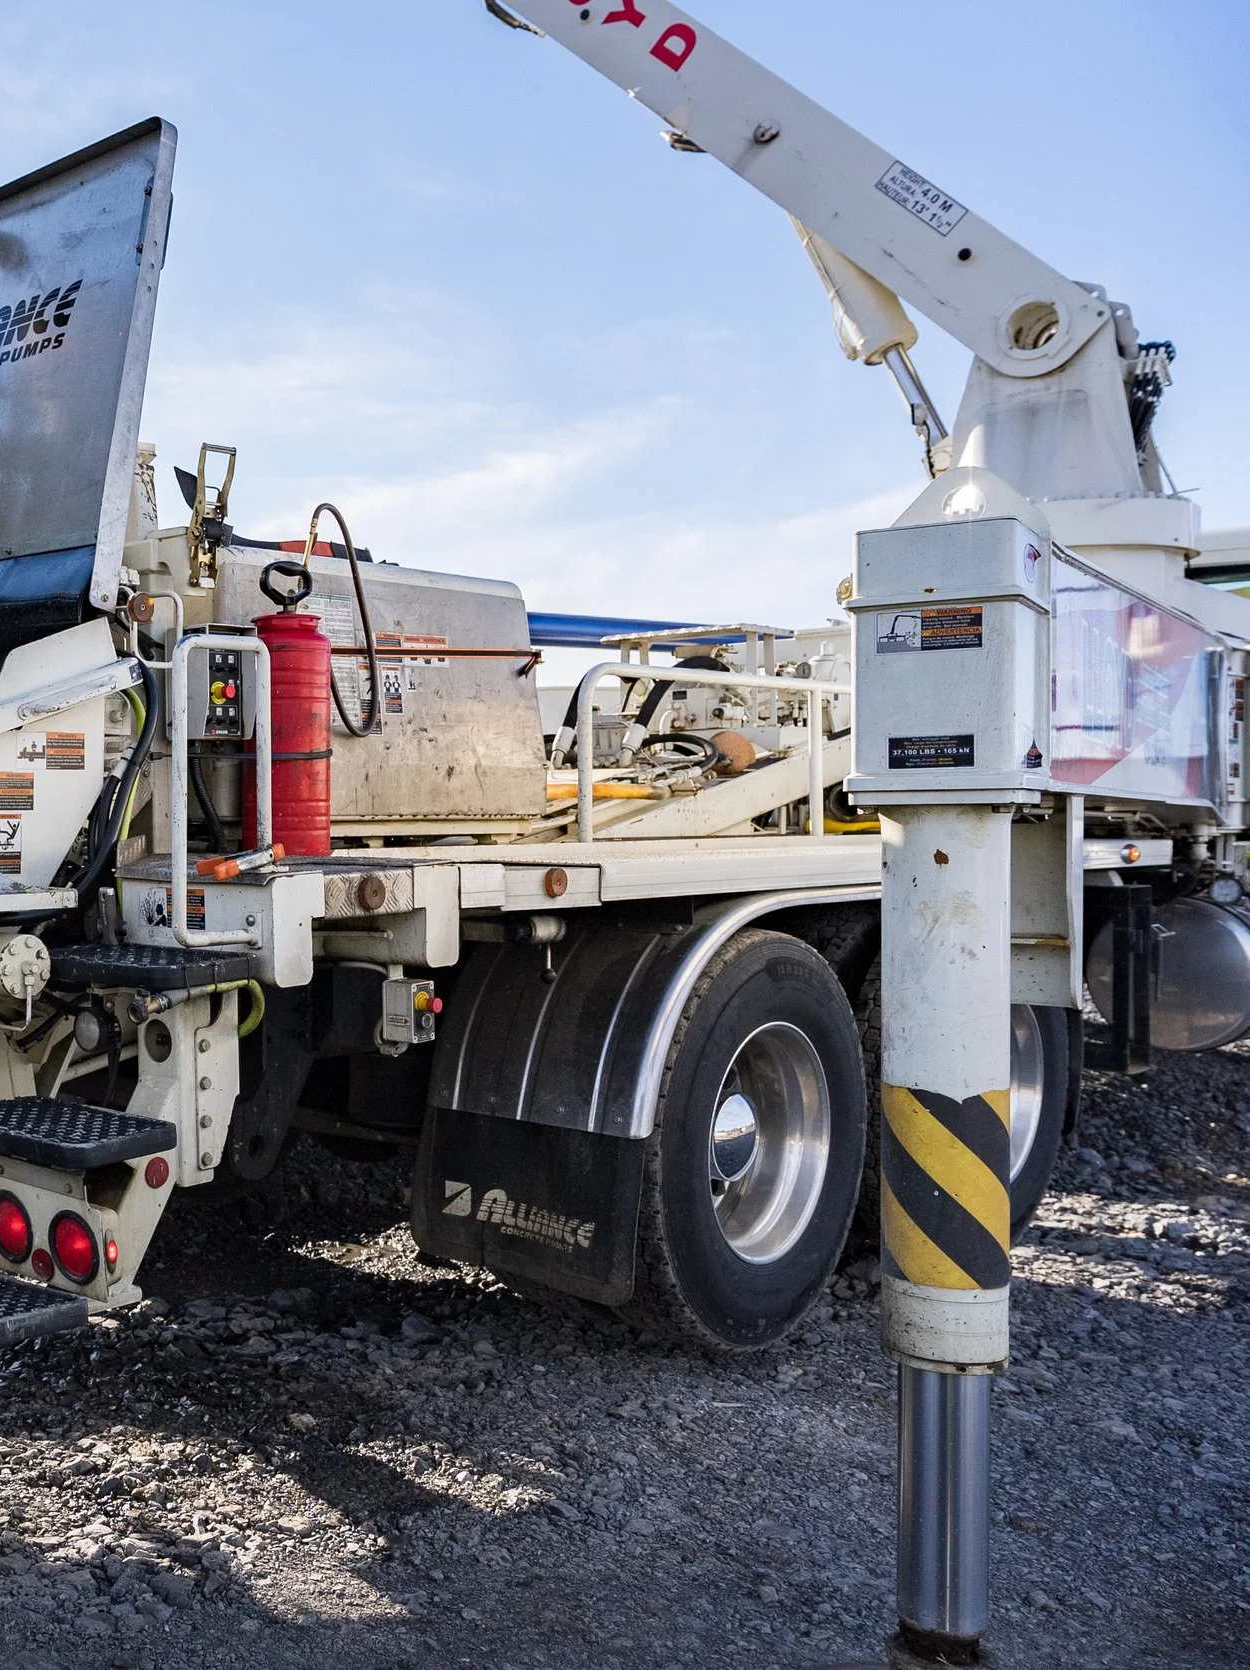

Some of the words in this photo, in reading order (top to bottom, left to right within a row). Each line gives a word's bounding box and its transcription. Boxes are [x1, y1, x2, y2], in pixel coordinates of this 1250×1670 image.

[567, 0, 698, 72] YD
[939, 199, 954, 213] M
[936, 607, 972, 616] WARNING
[931, 627, 980, 635] ADVERTENCIA
[476, 1188, 596, 1249] ALLIANCE
[500, 1226, 545, 1243] CONCRETE
